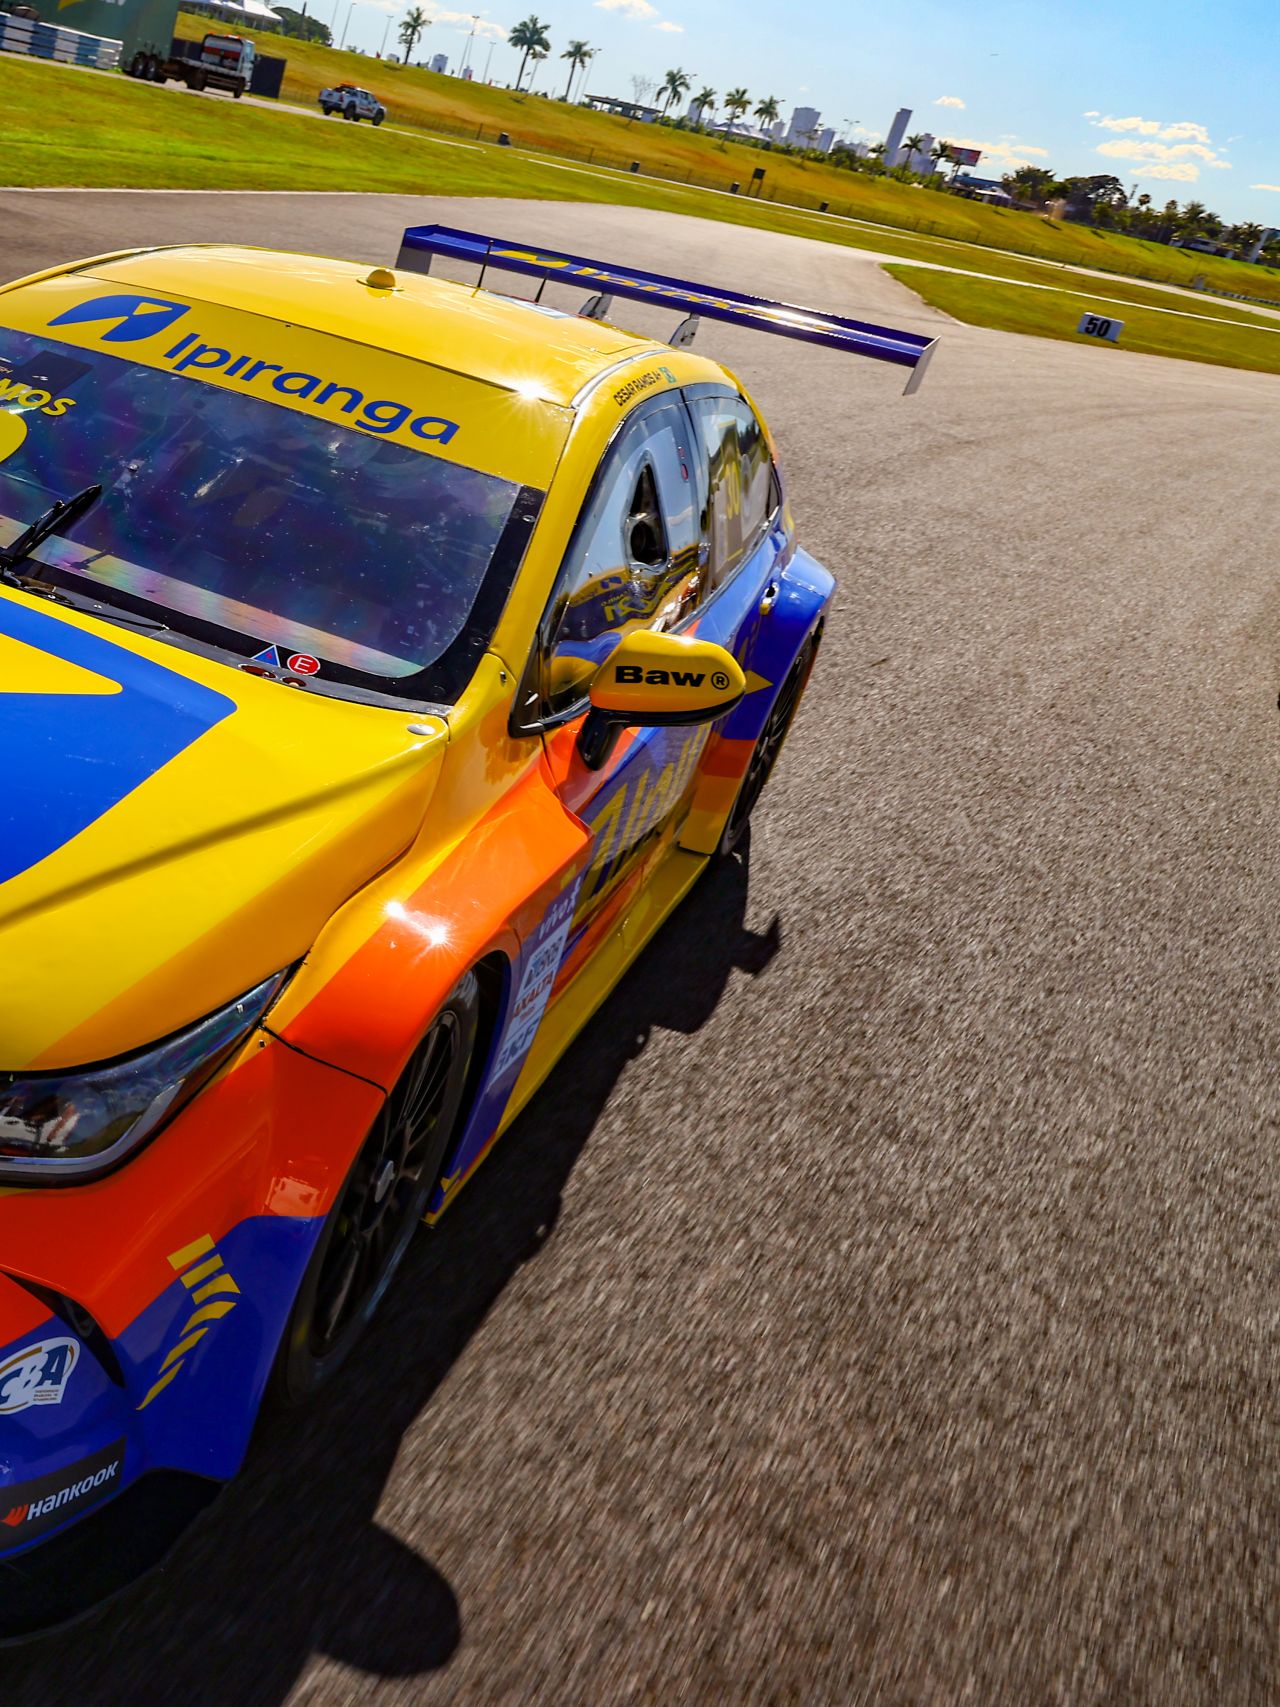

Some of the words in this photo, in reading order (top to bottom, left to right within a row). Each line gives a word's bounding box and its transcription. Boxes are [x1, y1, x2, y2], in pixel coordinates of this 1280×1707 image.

[1084, 317, 1111, 337] 50
[163, 332, 460, 446] Ipiranga
[294, 656, 313, 672] E
[615, 665, 705, 687] Baw
